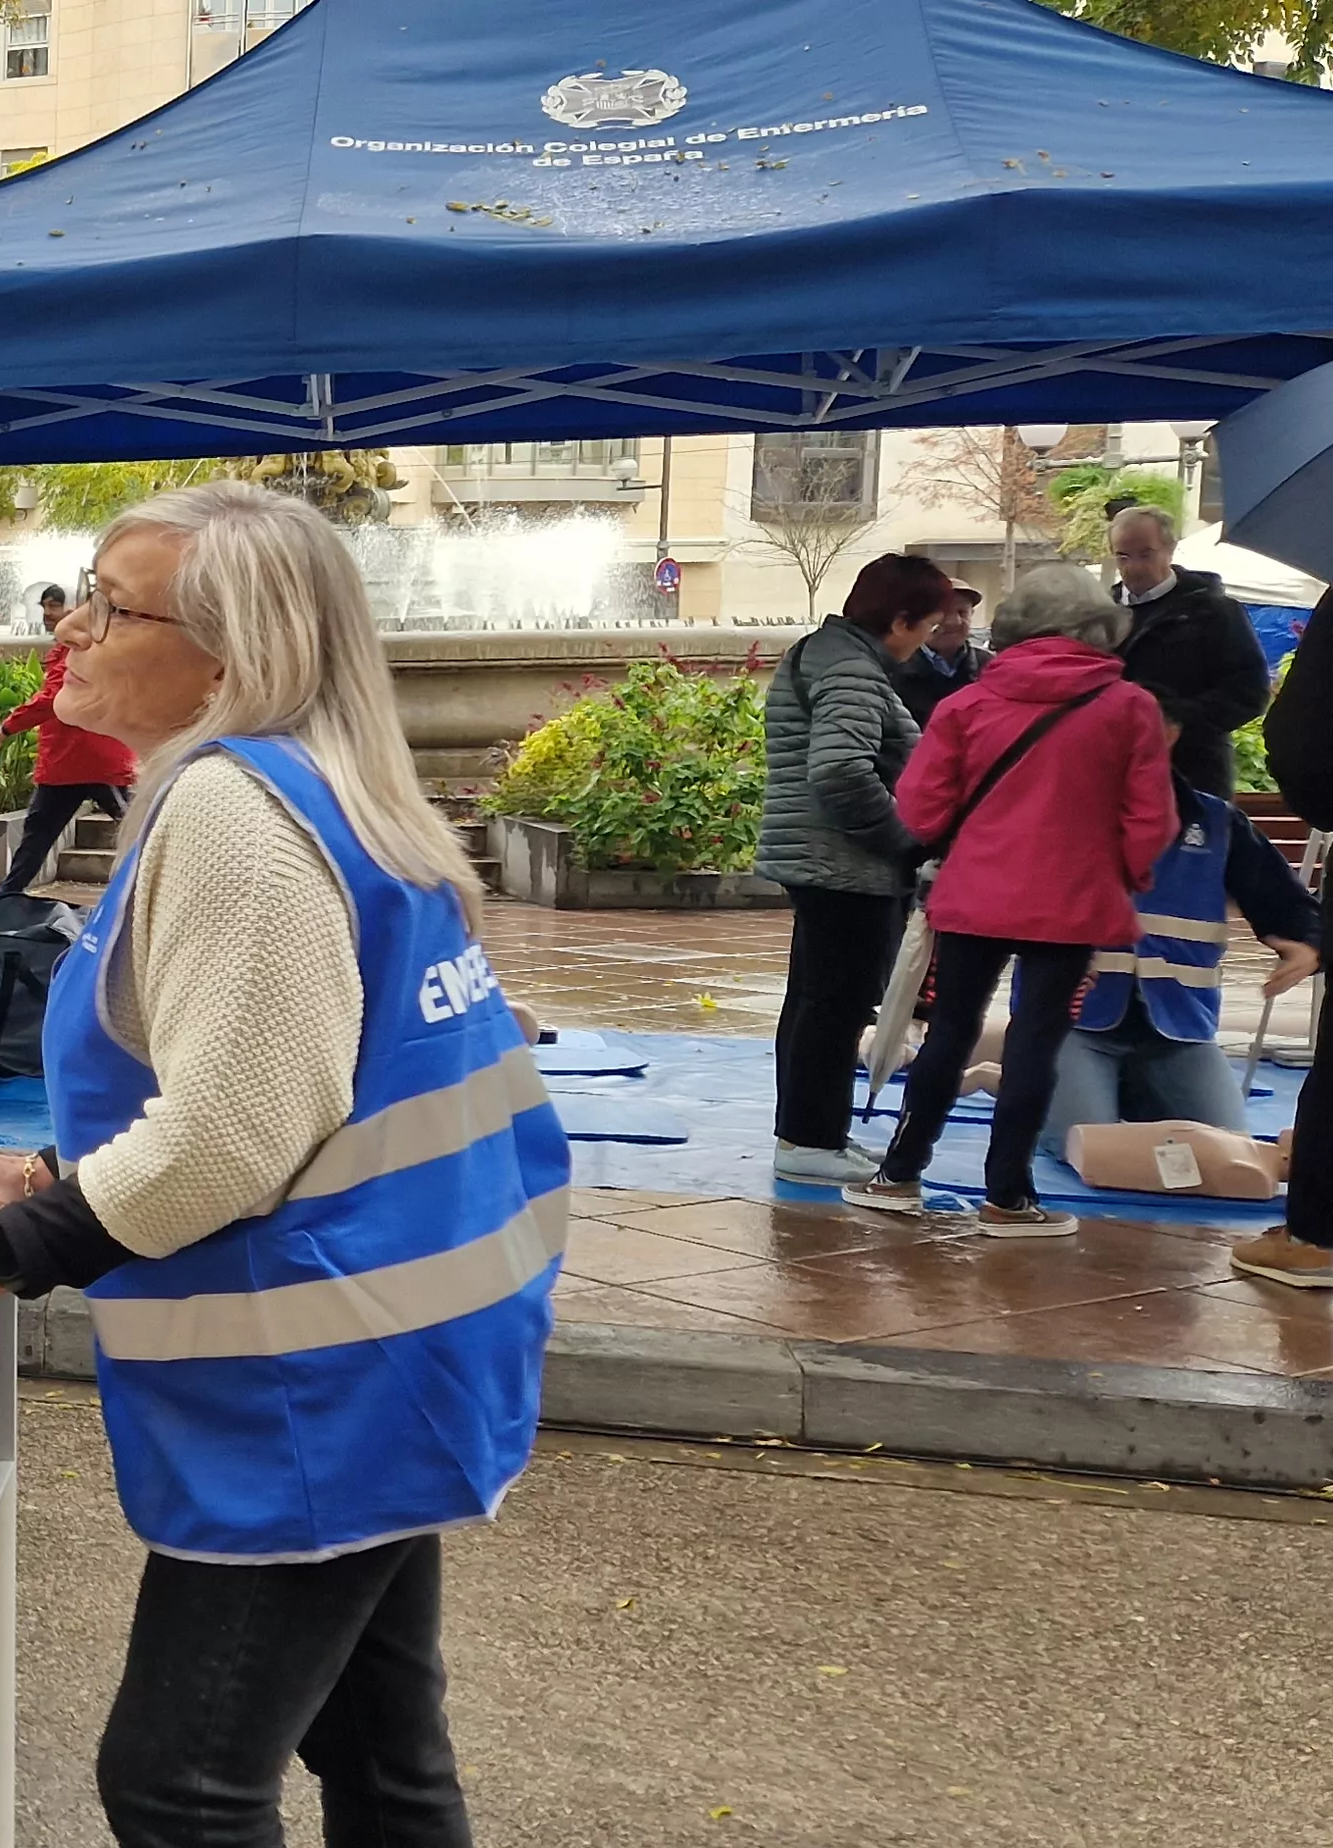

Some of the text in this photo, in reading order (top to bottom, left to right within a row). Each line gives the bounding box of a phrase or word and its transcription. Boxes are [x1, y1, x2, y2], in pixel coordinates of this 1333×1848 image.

[330, 103, 928, 154] Organización Colegial de Enfermería
[532, 155, 572, 168] de
